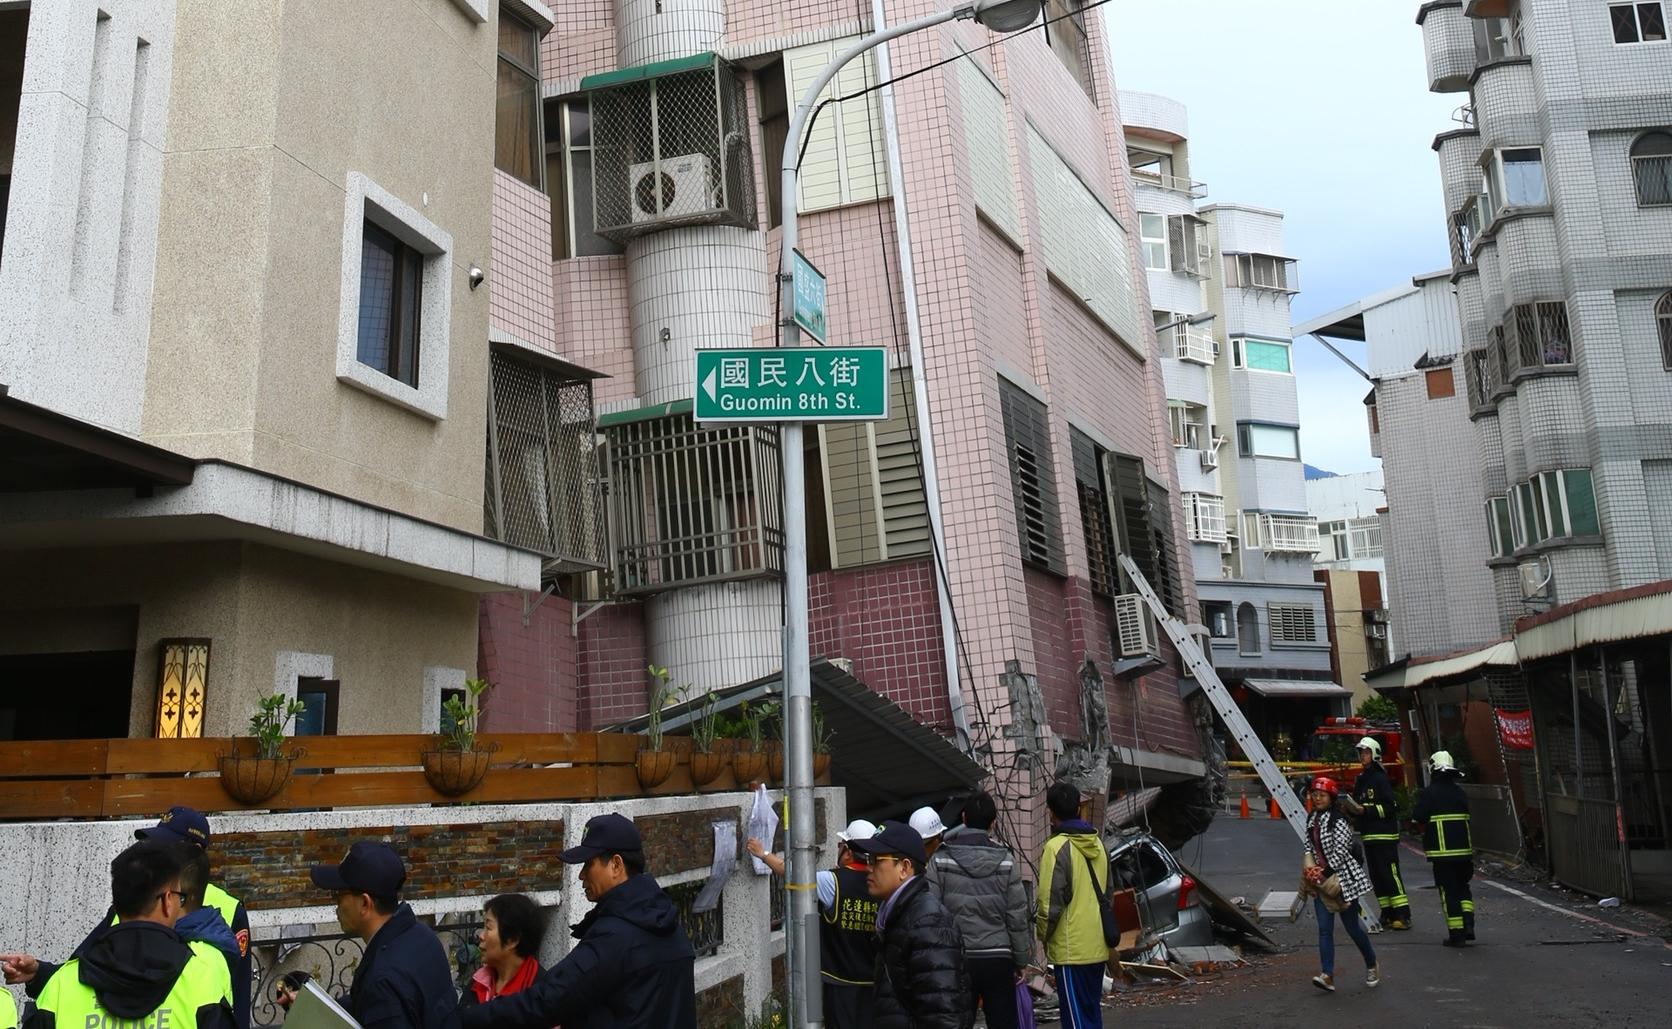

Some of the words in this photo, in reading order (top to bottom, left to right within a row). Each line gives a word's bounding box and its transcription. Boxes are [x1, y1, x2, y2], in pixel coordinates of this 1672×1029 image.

[720, 357, 860, 388] 國民八街
[720, 394, 791, 411] Guomin
[798, 393, 828, 410] 8th
[835, 392, 860, 410] St.
